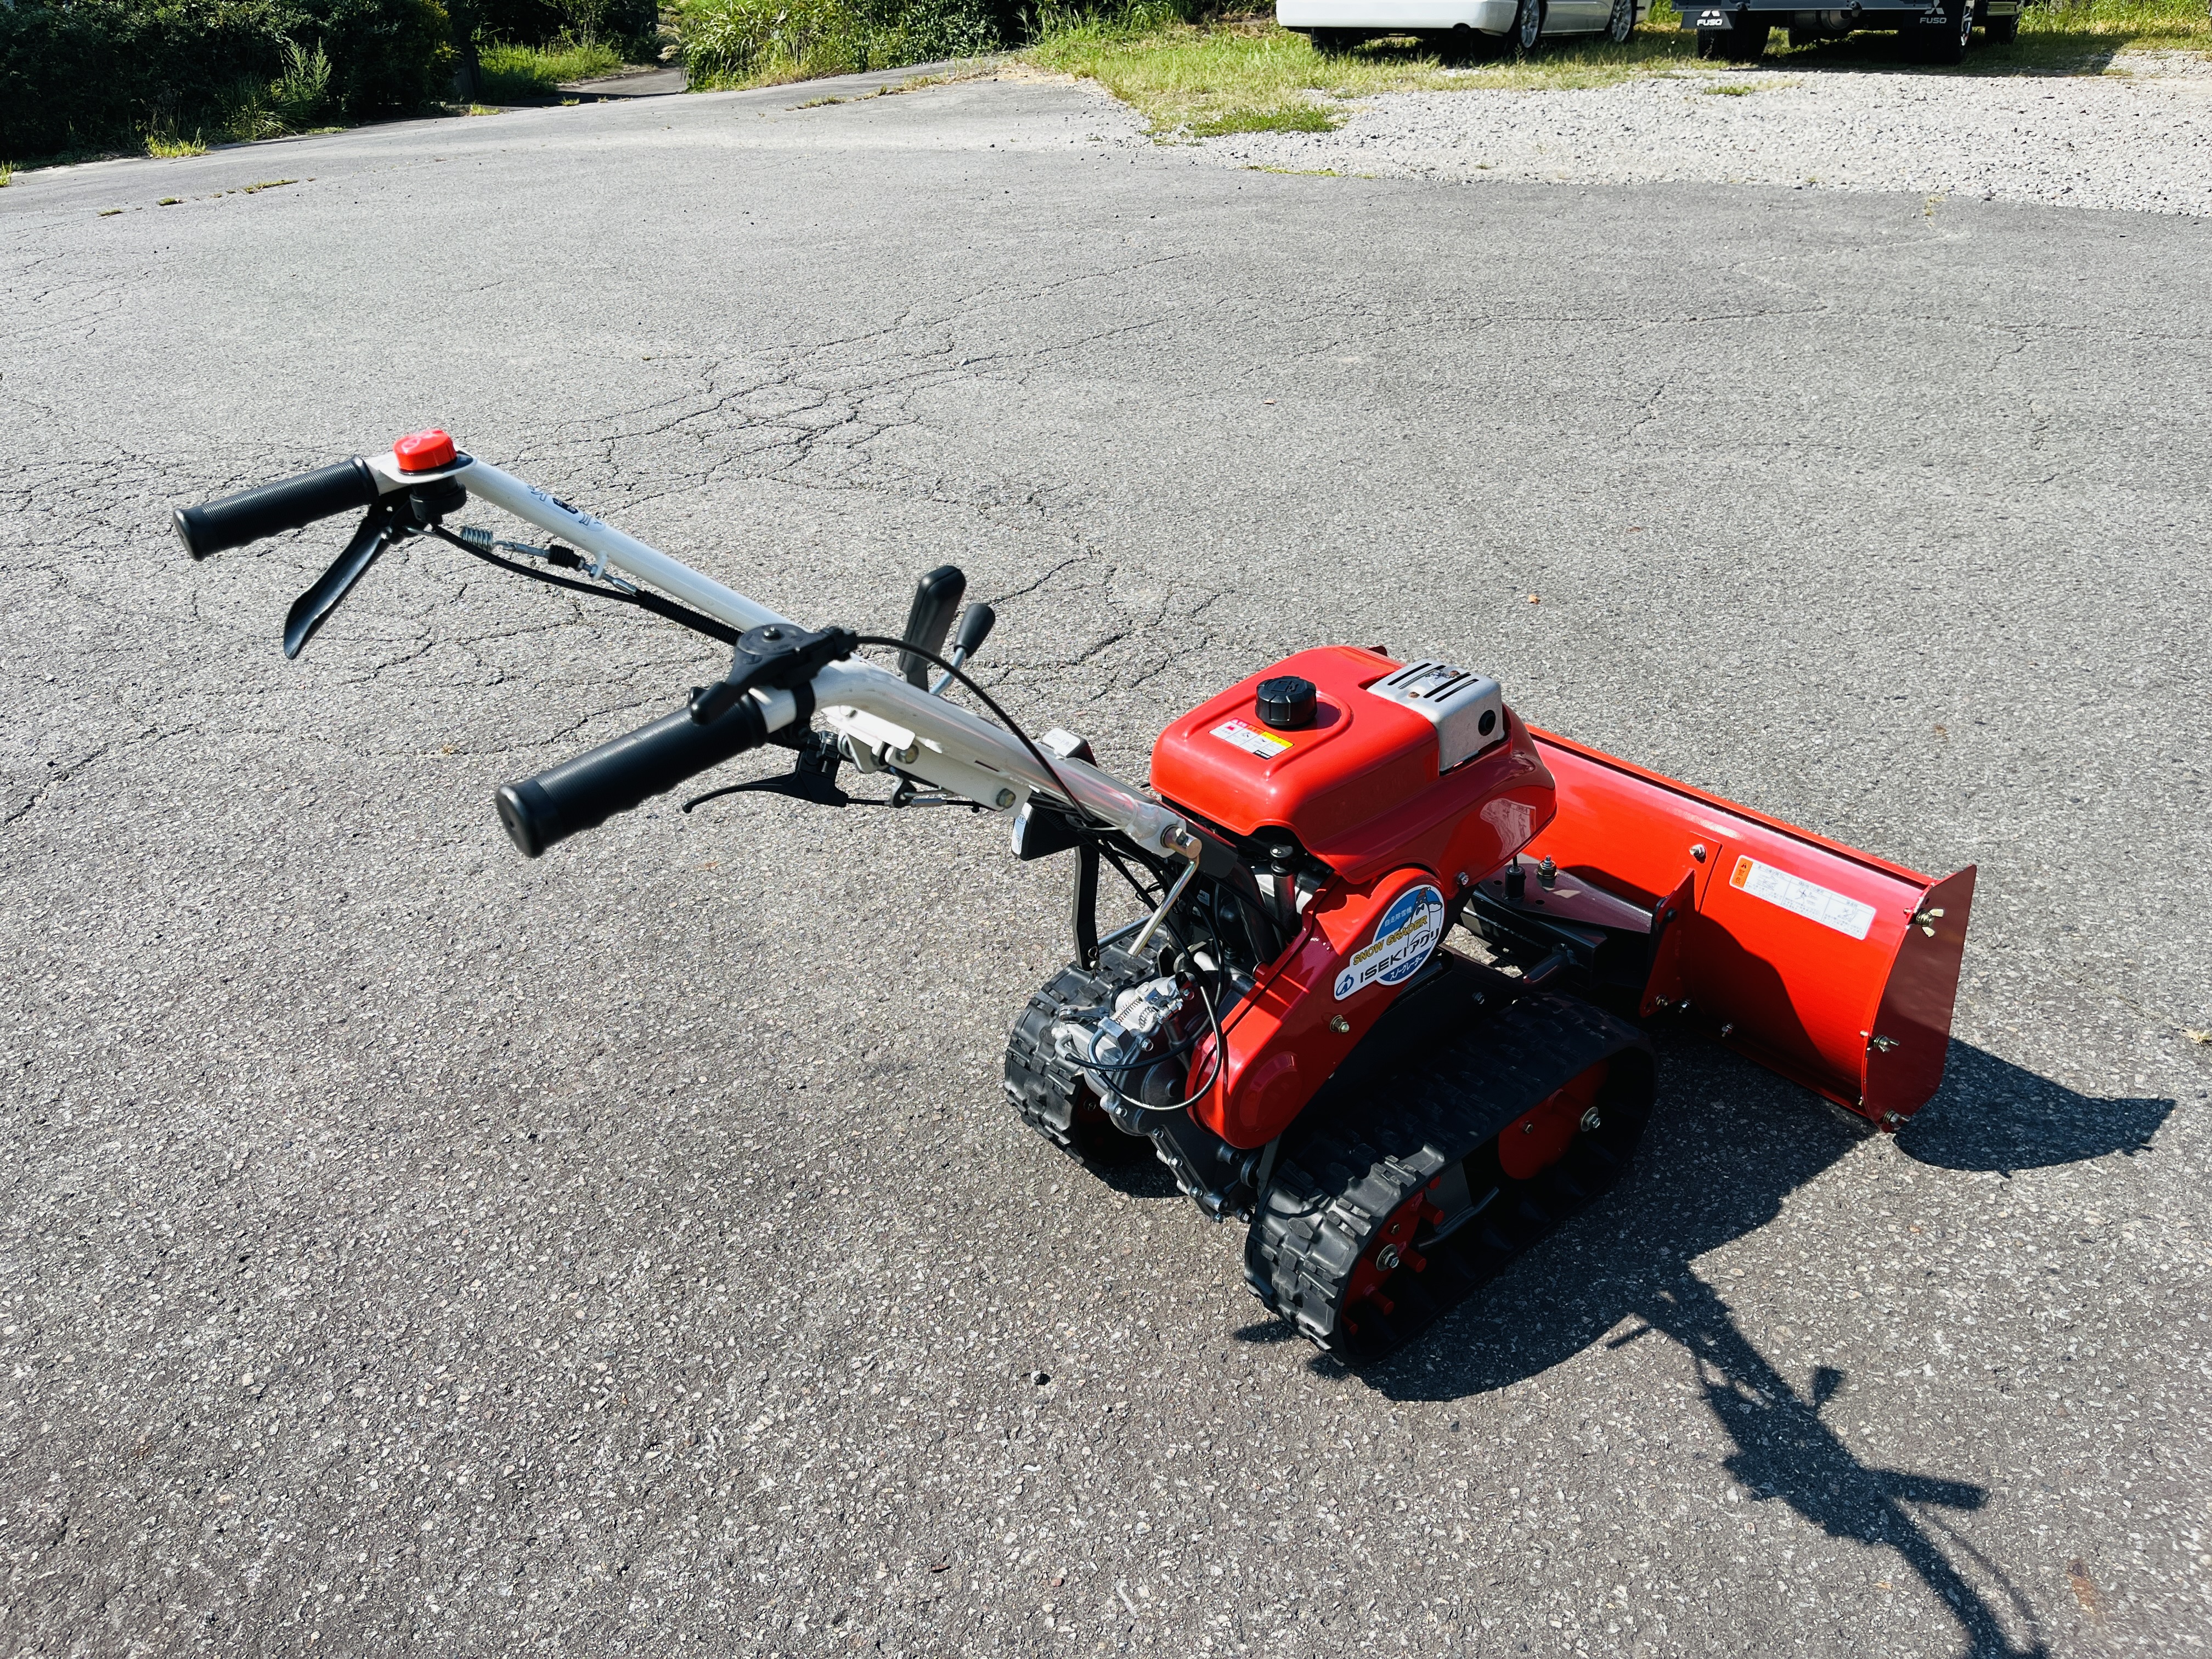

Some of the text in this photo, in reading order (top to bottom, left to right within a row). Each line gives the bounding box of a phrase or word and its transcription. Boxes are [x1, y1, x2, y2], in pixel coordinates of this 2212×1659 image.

[1353, 915, 1428, 966] SNOW GRADER
[1390, 955, 1423, 981] スノーグレーダー
